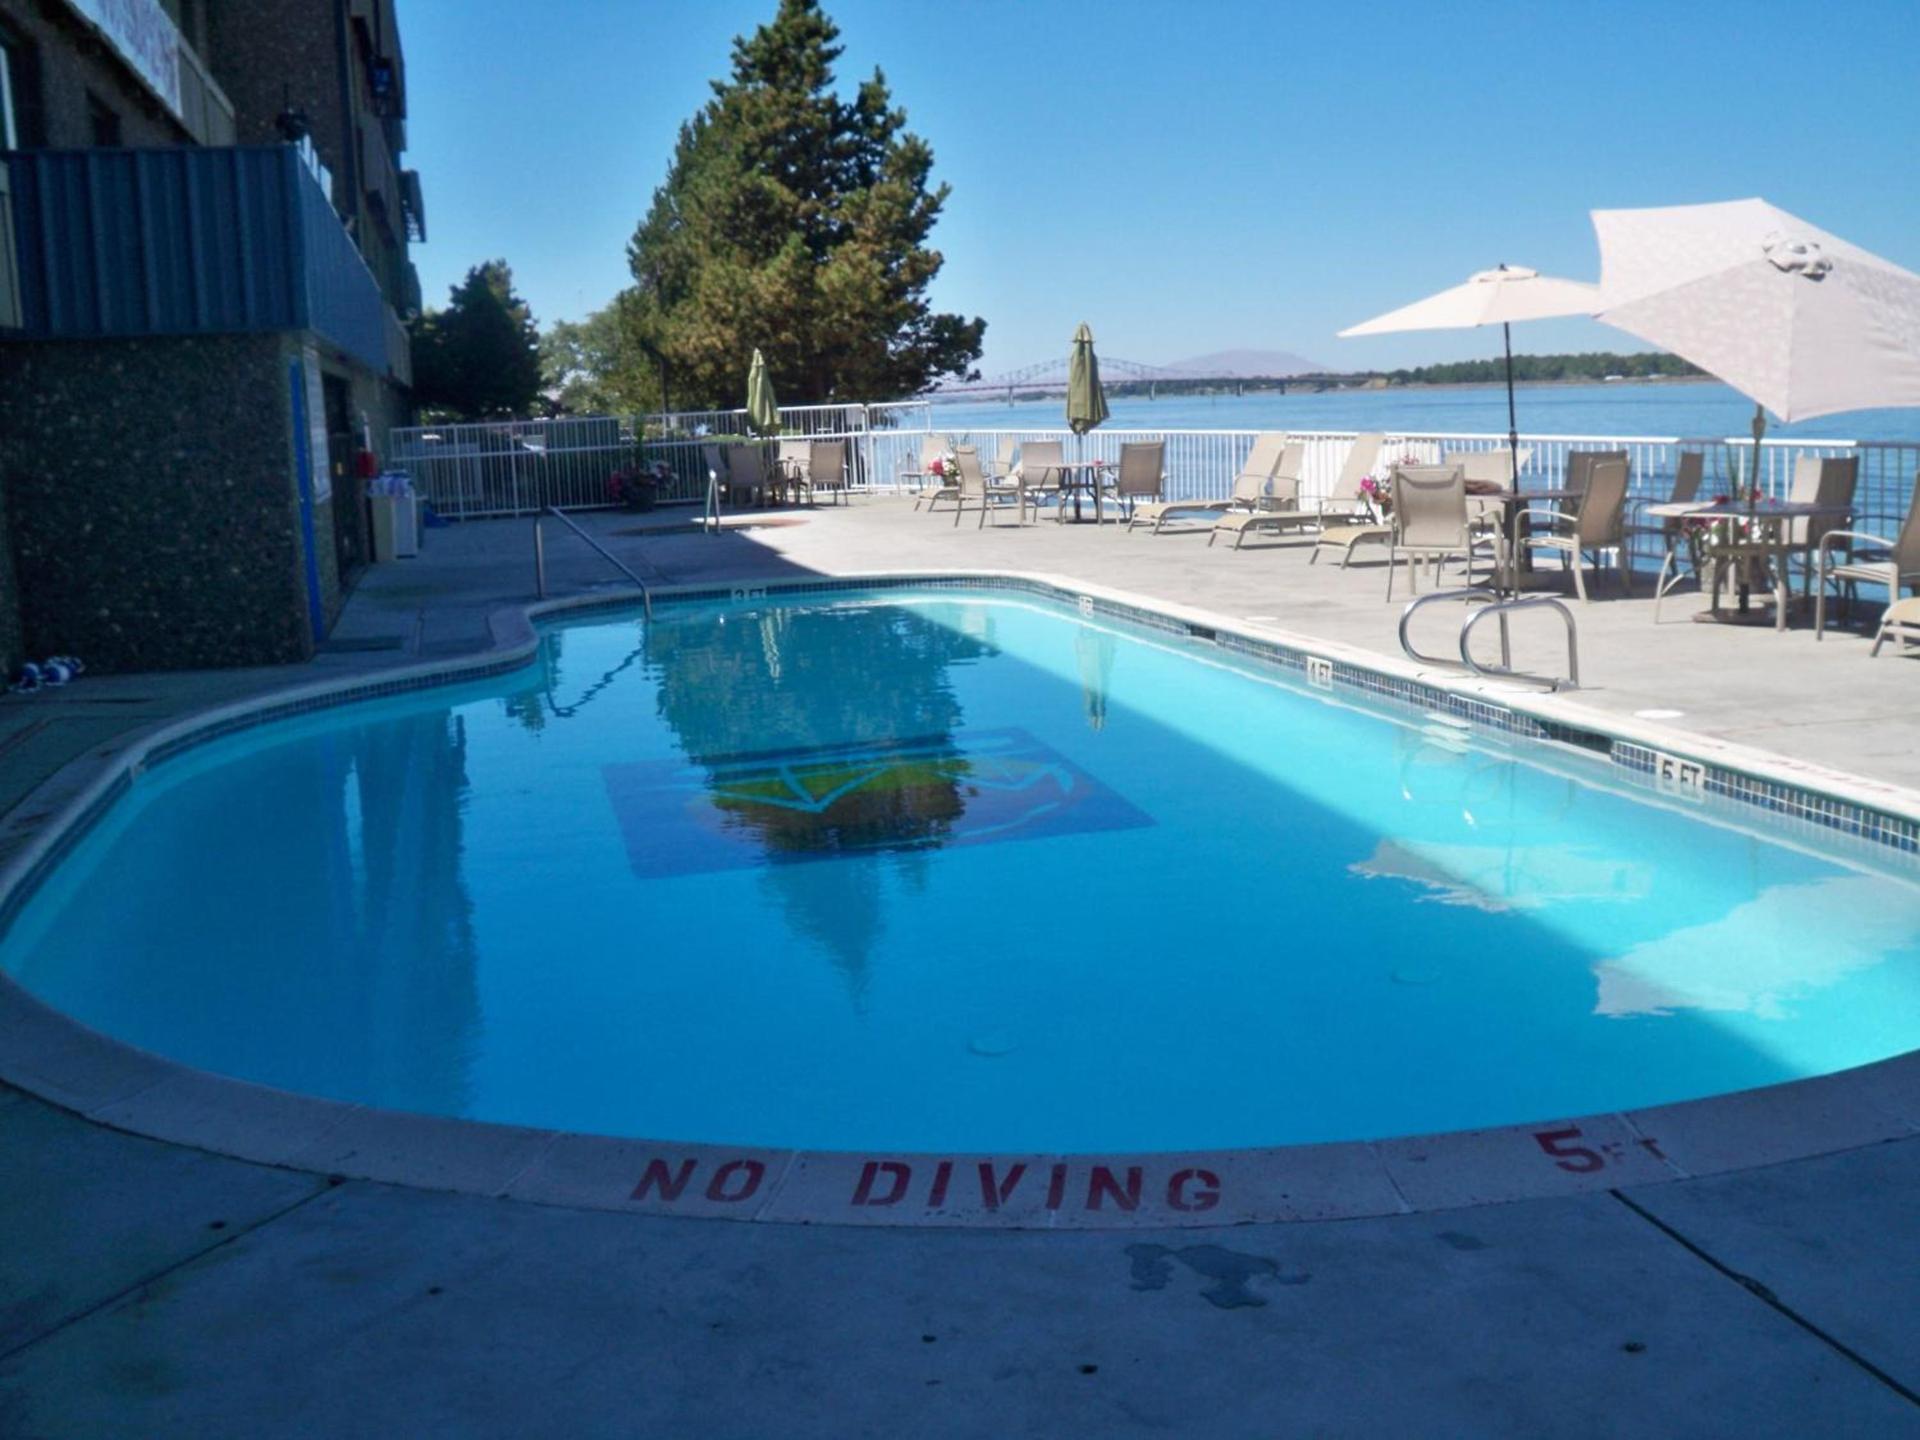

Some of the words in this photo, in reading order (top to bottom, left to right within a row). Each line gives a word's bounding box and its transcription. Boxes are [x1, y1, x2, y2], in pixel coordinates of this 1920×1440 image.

[1662, 759, 1673, 780] 5
[1680, 763, 1701, 786] FT
[1534, 1128, 1605, 1173] 5
[630, 1158, 766, 1202] NO
[850, 1160, 1222, 1213] DIVING
